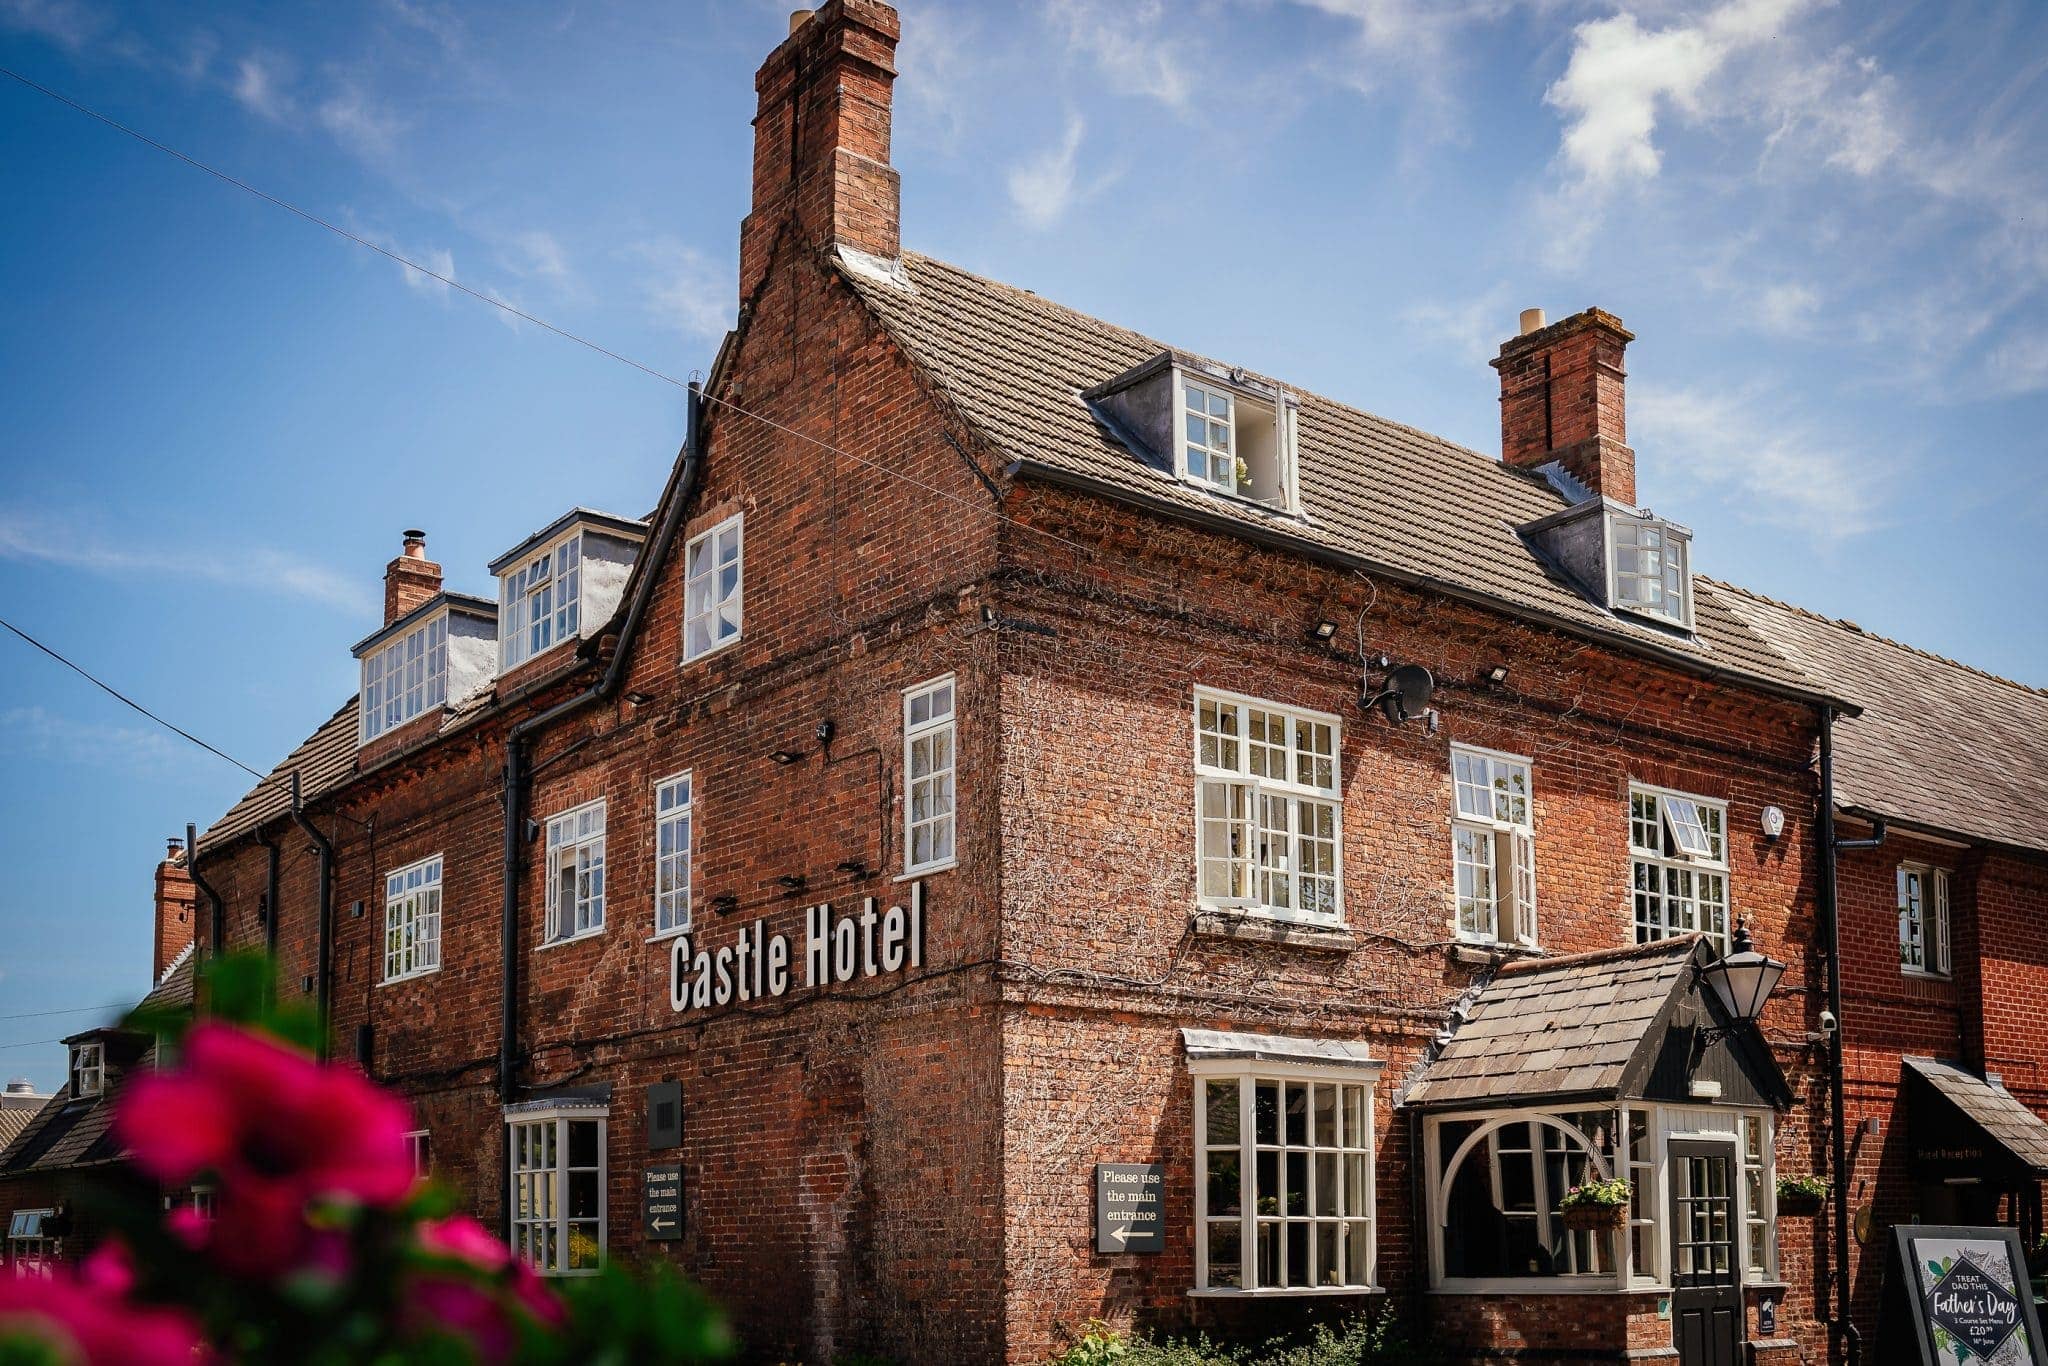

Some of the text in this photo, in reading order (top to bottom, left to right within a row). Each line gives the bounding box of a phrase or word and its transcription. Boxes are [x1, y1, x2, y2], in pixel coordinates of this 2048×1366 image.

[670, 881, 921, 1013] Castle Hotel
[646, 1172, 679, 1182] Please use
[1102, 1170, 1160, 1184] Please use
[649, 1187, 677, 1198] the main
[1107, 1189, 1156, 1202] the main
[649, 1203, 677, 1214] entrance
[1107, 1210, 1157, 1221] entrance
[1955, 1275, 1980, 1283] TREAT
[1951, 1282, 1988, 1291] DAD THIS
[1934, 1290, 2018, 1324] Father's Day
